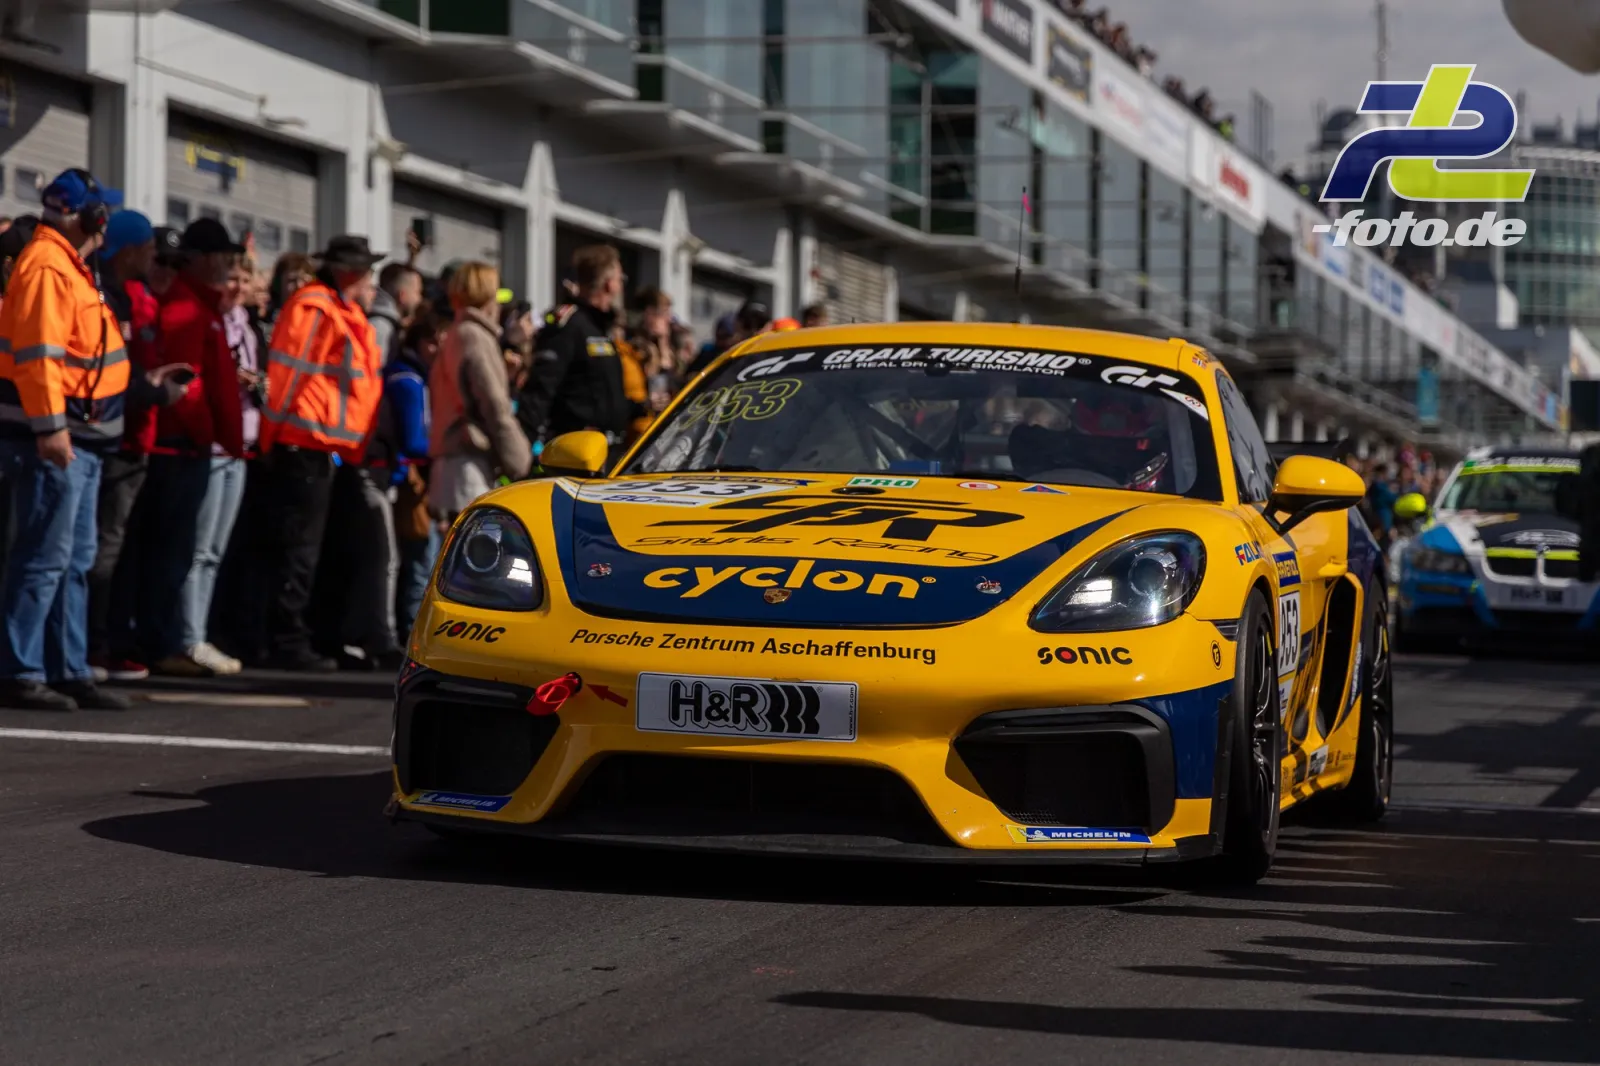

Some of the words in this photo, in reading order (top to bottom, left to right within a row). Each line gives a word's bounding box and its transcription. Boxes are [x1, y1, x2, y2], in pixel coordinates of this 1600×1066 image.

[821, 362, 855, 371] THE
[856, 361, 897, 369] REAL
[971, 362, 1065, 376] SIMULATOR
[823, 348, 921, 365] GRAN
[679, 378, 802, 431] 953
[603, 481, 763, 496] 953
[850, 478, 915, 487] PRO
[813, 536, 1000, 561] Racing
[1280, 598, 1298, 669] 953
[570, 628, 654, 648] Porsche
[658, 633, 755, 653] Zentrum
[760, 637, 936, 665] Aschaffenburg
[668, 680, 768, 732] H&R
